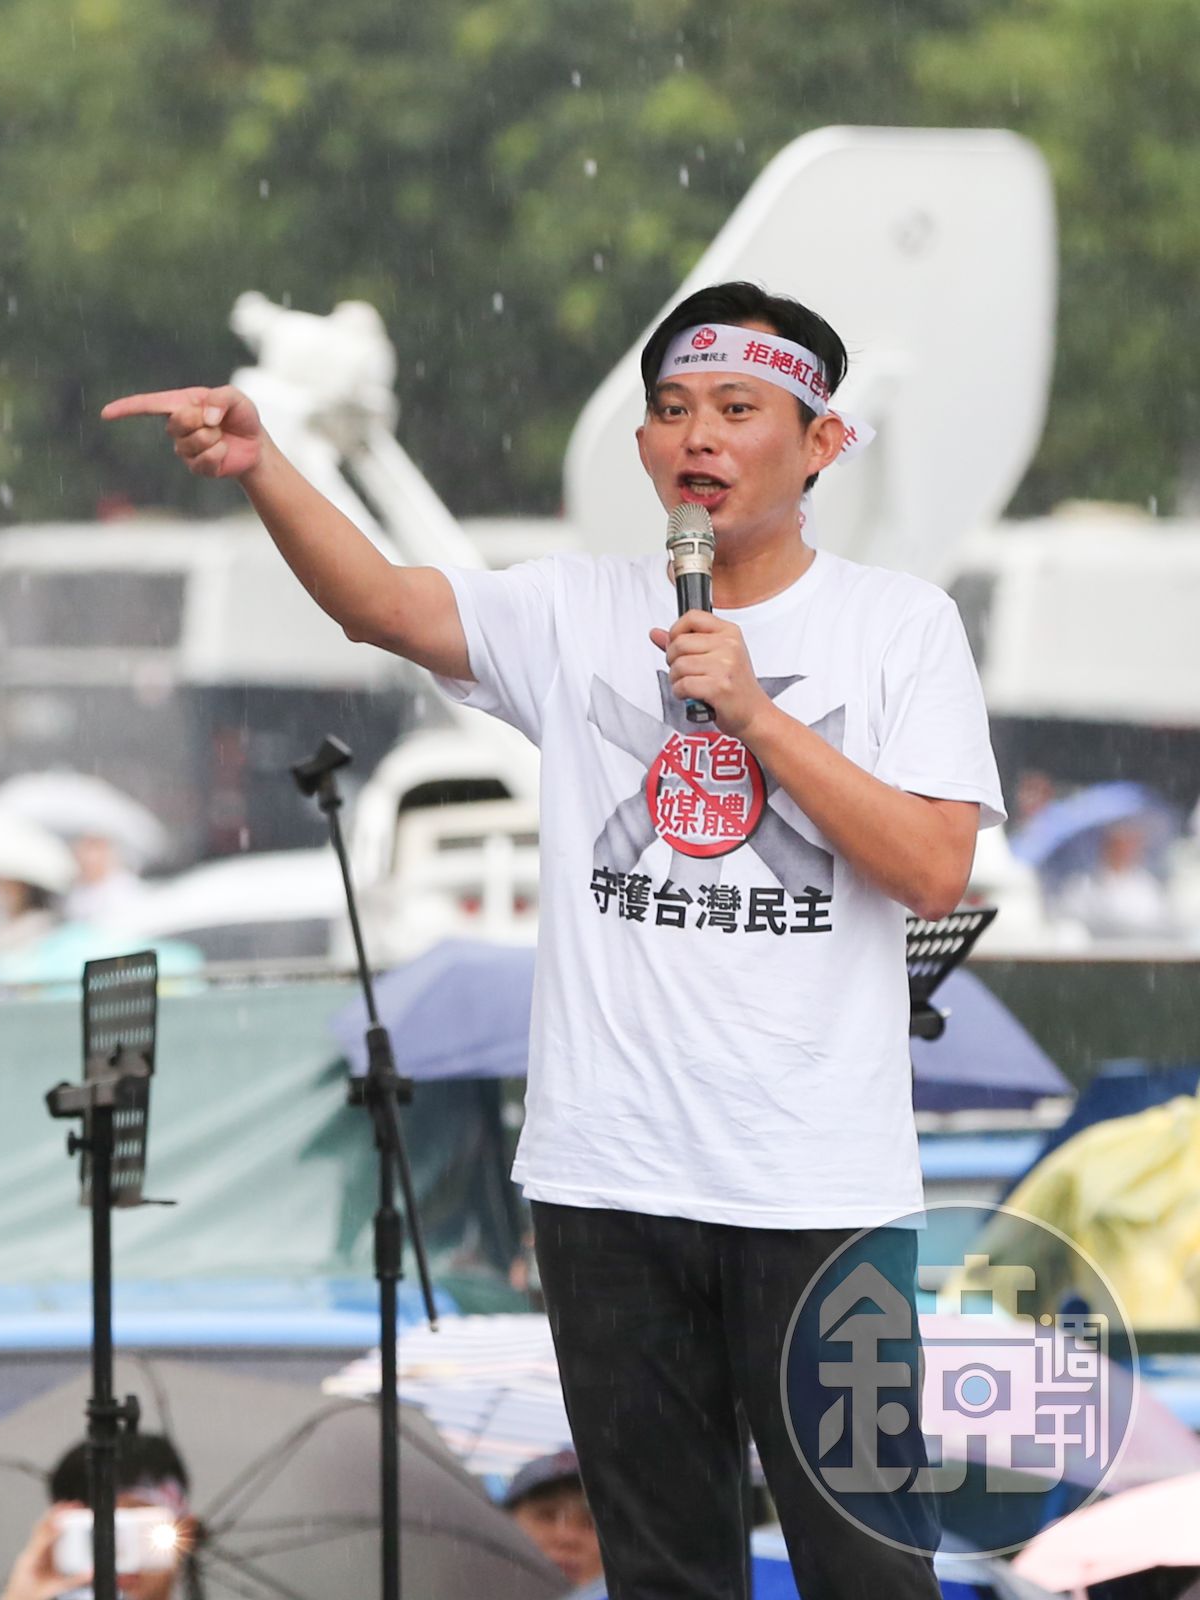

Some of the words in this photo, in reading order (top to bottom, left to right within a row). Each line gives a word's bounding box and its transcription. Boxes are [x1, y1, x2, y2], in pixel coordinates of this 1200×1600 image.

[743, 341, 830, 402] 拒絕紅色
[660, 732, 747, 782] 紅色
[656, 789, 747, 838] 媒體
[589, 866, 833, 936] 守護台灣民主
